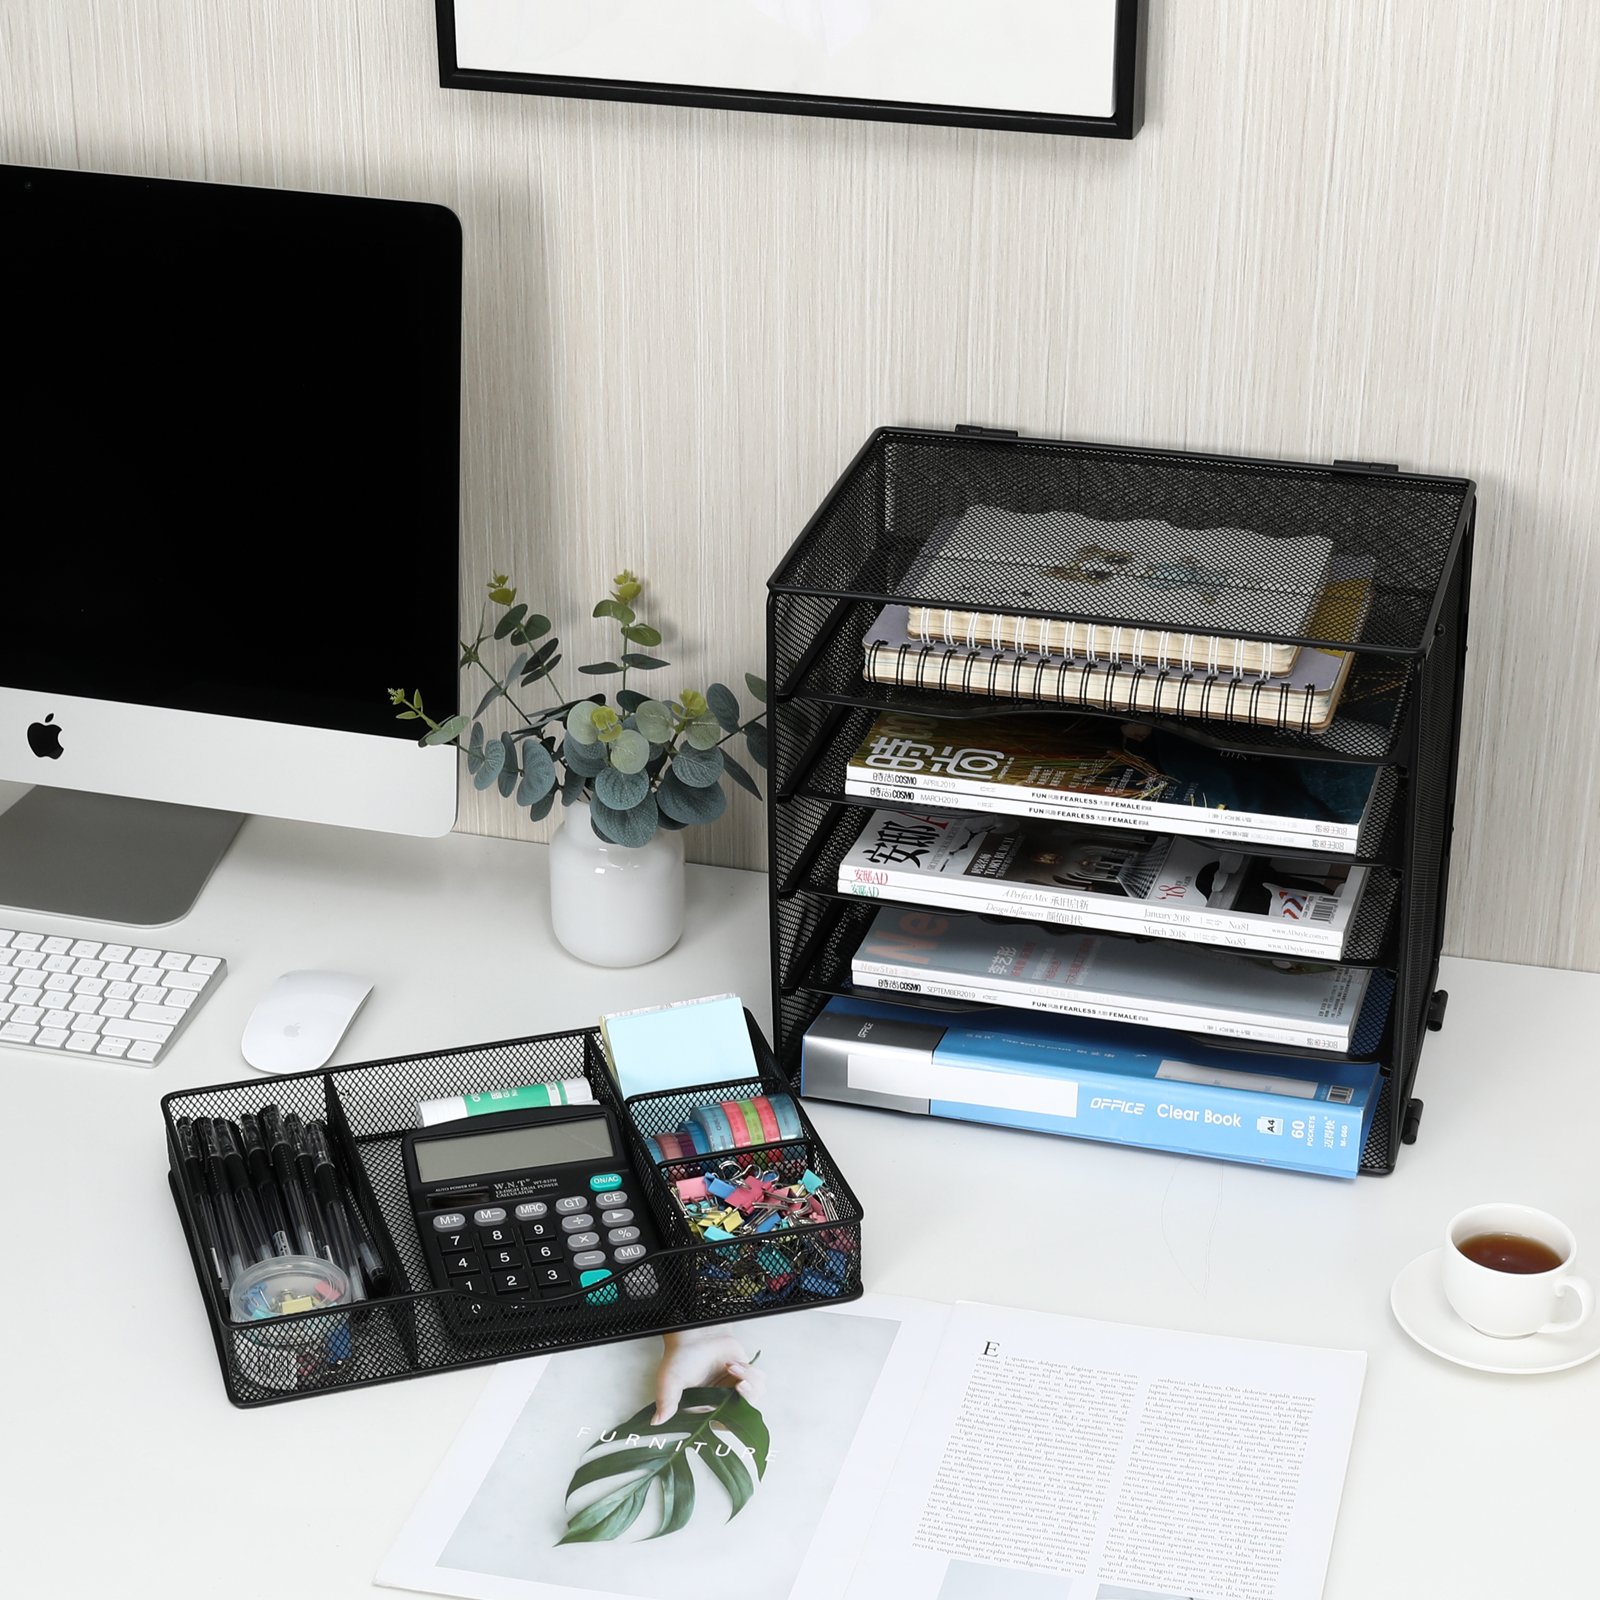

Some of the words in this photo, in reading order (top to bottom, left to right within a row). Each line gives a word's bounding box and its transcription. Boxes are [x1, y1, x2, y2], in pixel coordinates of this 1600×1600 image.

[1059, 795, 1098, 805] FEARLESS
[1110, 801, 1140, 810] FEMALE
[1028, 807, 1044, 815] FUN
[1057, 811, 1095, 820] FEARLESS
[1108, 817, 1138, 825] FEMALE
[1010, 890, 1033, 901] Perfect
[986, 903, 1008, 915] Design
[1009, 905, 1044, 918] Influencers
[1144, 908, 1171, 922] January
[1173, 913, 1190, 923] 2018
[1143, 925, 1167, 936] March
[1169, 928, 1187, 938] 2018
[1059, 1005, 1097, 1014] FEARLESS
[1109, 1011, 1138, 1021] FEMALE
[1090, 1097, 1146, 1115] OFFICE
[1157, 1103, 1200, 1122] Clear
[1204, 1109, 1242, 1128] Book
[1266, 1119, 1276, 1133] A4
[1291, 1120, 1305, 1139] 60
[1306, 1115, 1316, 1147] POCKETS
[593, 1175, 619, 1185] ON/AC
[495, 1189, 534, 1198] CALCULATOR
[521, 1184, 536, 1192] DUAL
[564, 1198, 581, 1208] GT
[603, 1193, 621, 1202] CE
[520, 1203, 544, 1214] MRC
[439, 1215, 460, 1225] M+
[534, 1224, 544, 1234] 9
[450, 1235, 460, 1246] 7
[492, 1230, 502, 1240] 8
[541, 1247, 551, 1257] 6
[620, 1246, 640, 1257] MU
[458, 1257, 468, 1268] 4
[500, 1252, 510, 1263] 5
[547, 1269, 558, 1280] 3
[465, 1280, 473, 1291] 1
[506, 1275, 517, 1287] 2
[982, 1341, 1000, 1357] E
[577, 1427, 779, 1463] FURNITURE
